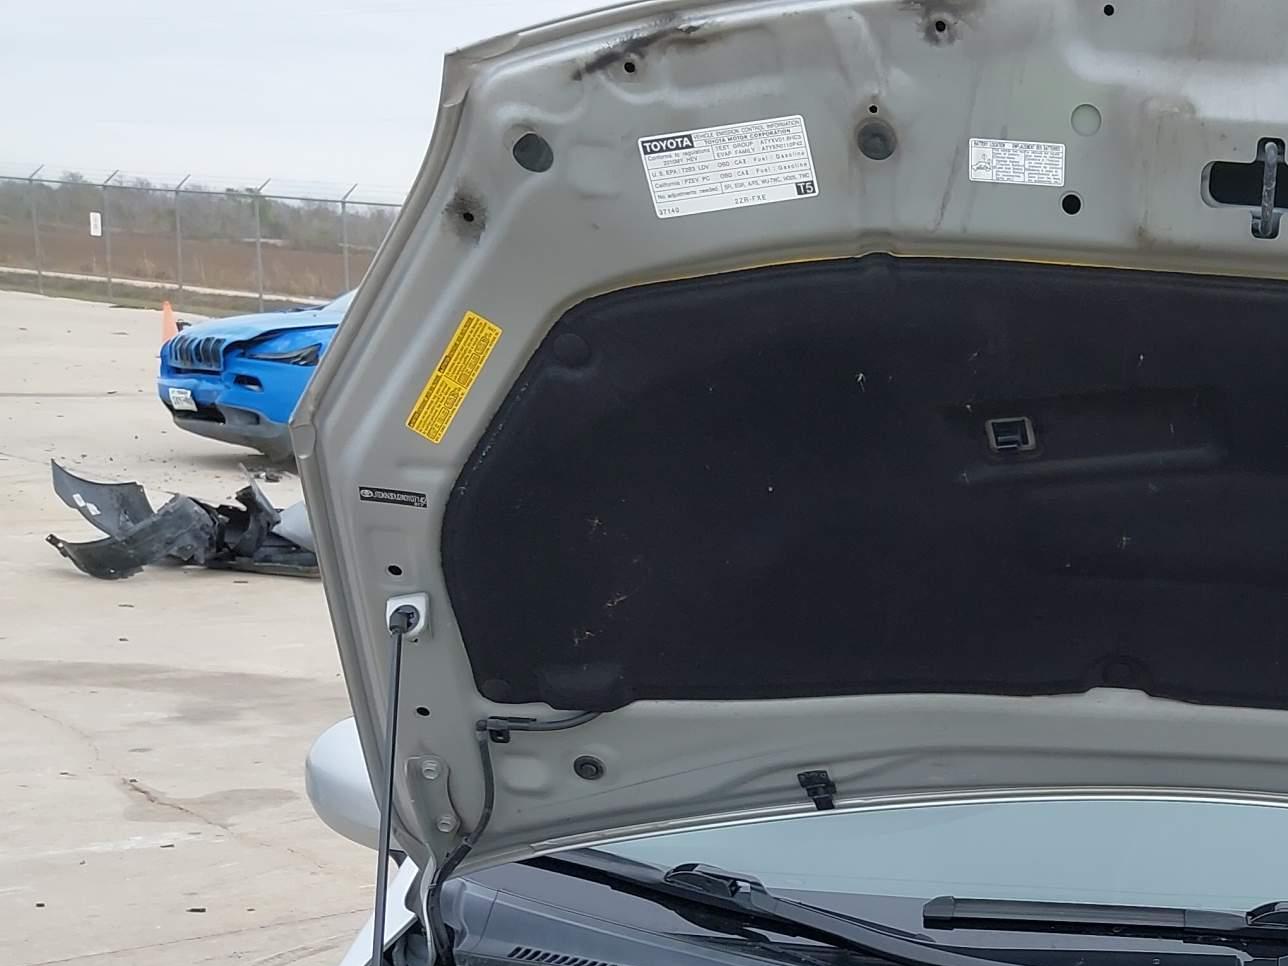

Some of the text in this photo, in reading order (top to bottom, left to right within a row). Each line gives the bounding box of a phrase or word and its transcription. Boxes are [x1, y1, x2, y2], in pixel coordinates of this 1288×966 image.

[642, 136, 692, 153] TOYOTA
[704, 137, 725, 145] TOYOTA
[749, 128, 791, 138] CORPORATION
[798, 182, 814, 193] T5
